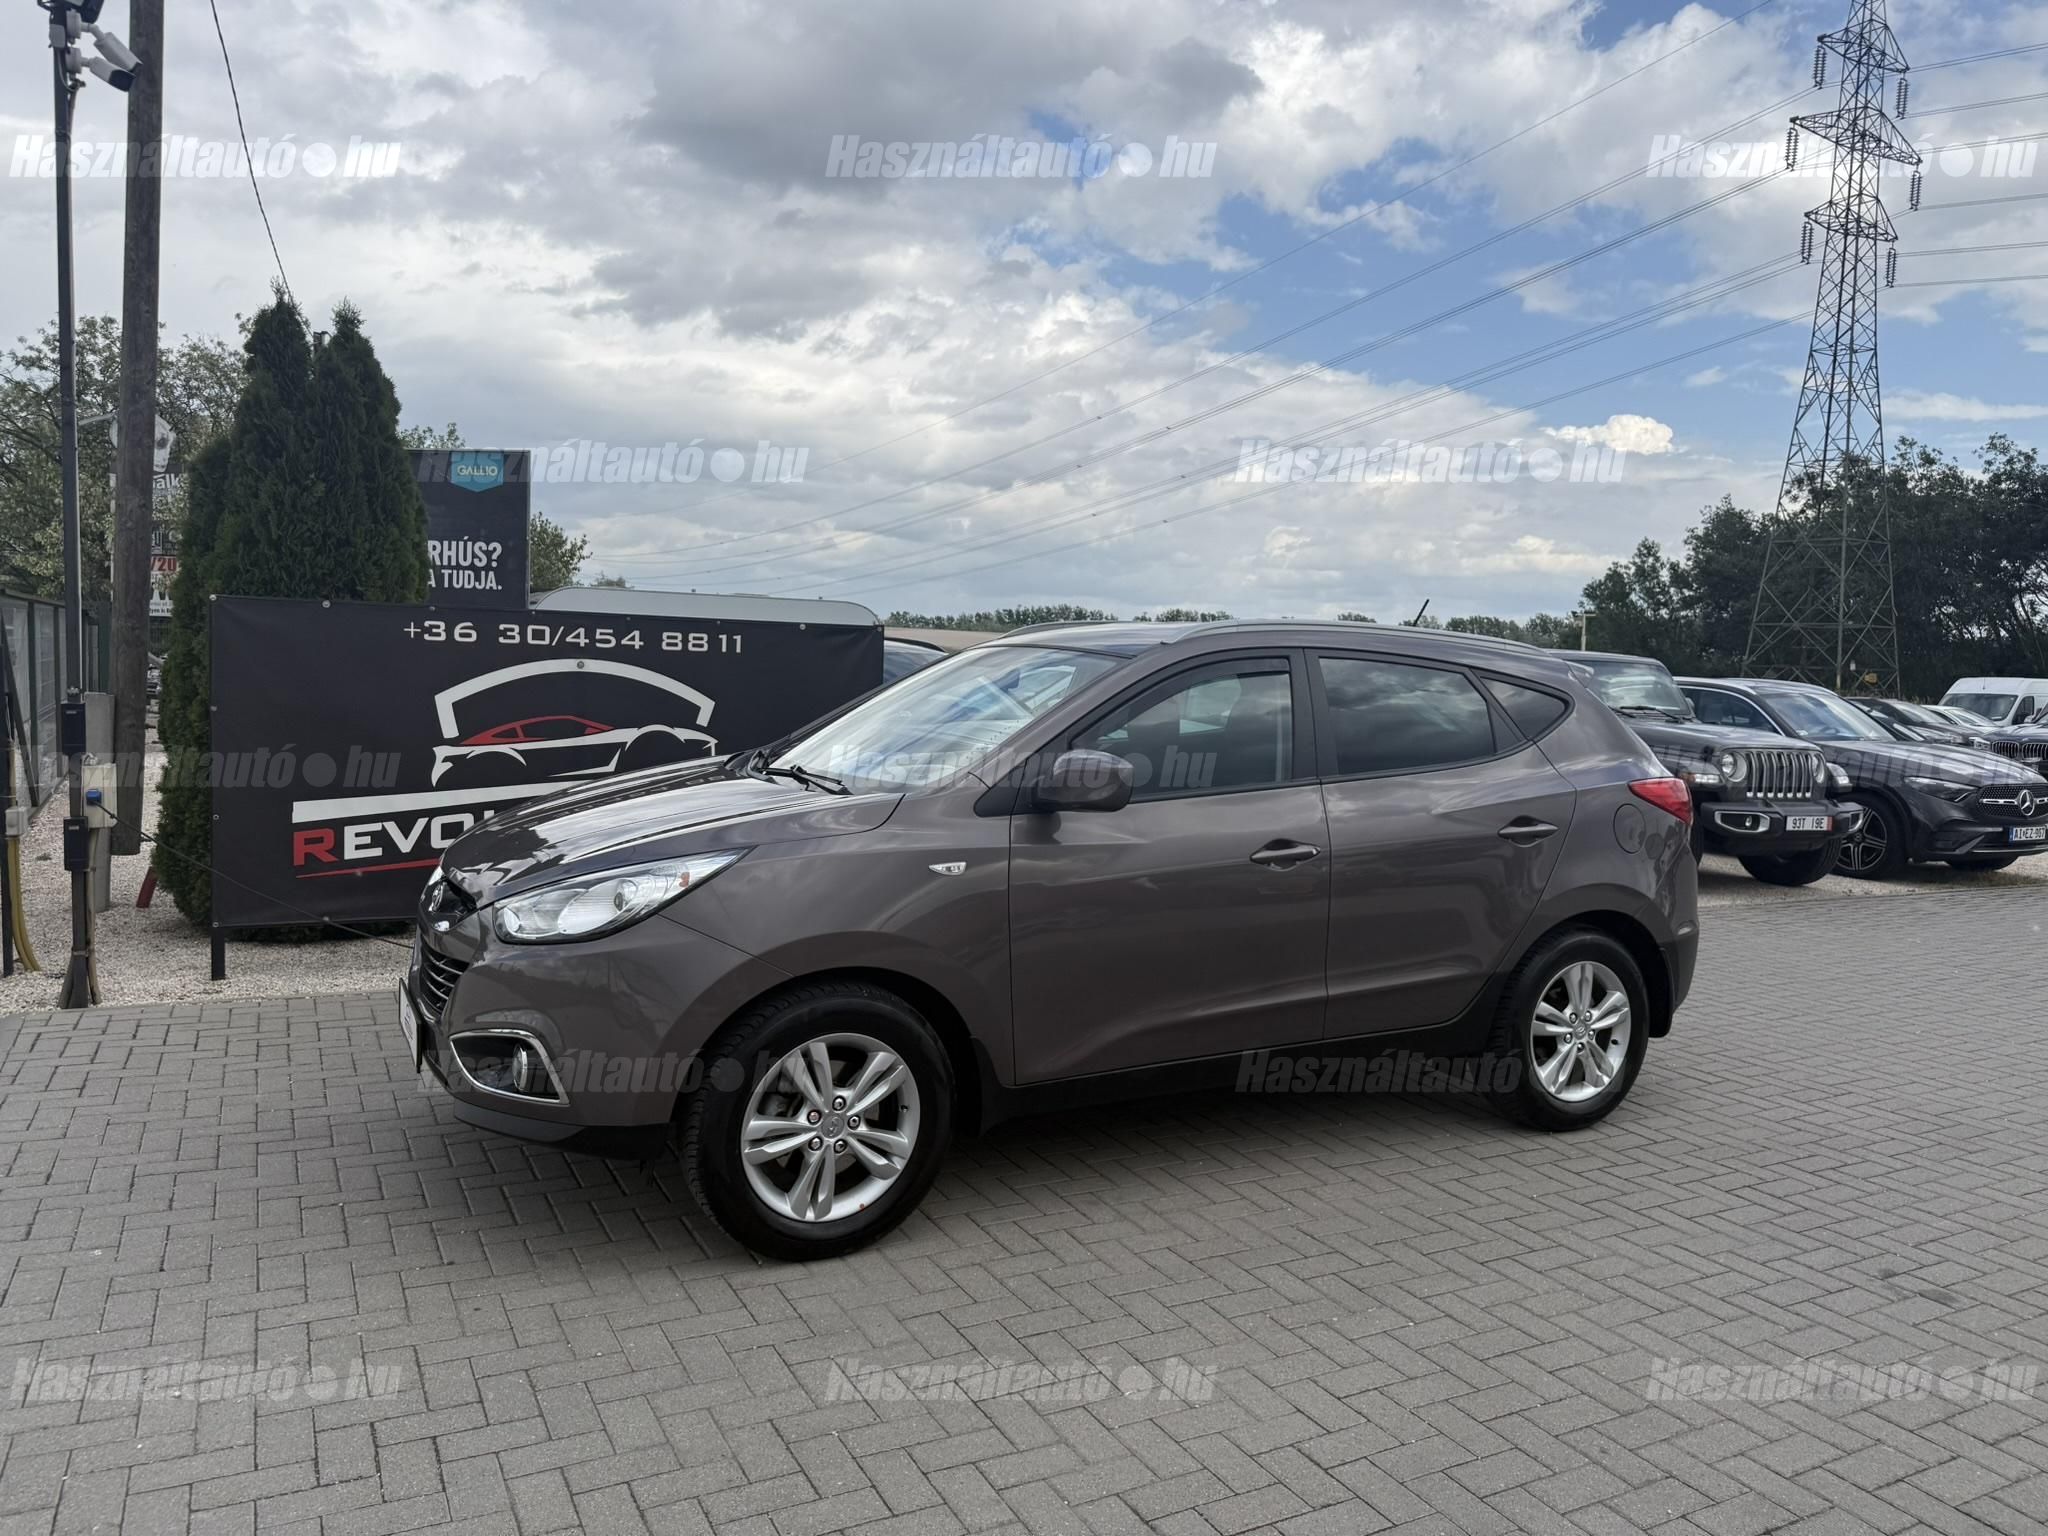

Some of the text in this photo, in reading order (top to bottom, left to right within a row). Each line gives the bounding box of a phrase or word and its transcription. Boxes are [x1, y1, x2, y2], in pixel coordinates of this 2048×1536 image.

[441, 569, 503, 590] TUDJA.
[403, 620, 477, 642] +36
[498, 624, 645, 649] 30/454
[293, 810, 495, 867] REVO
